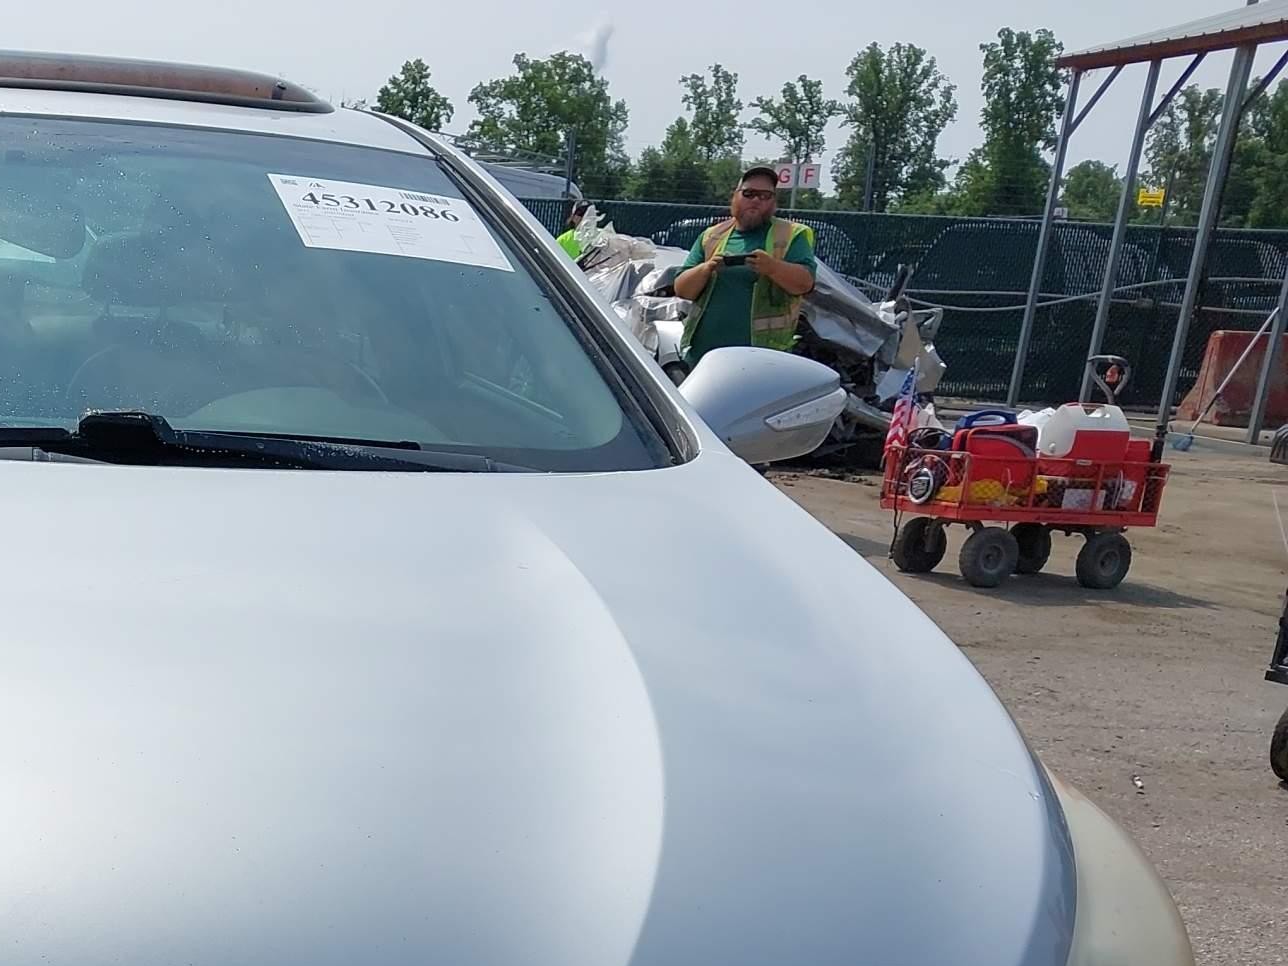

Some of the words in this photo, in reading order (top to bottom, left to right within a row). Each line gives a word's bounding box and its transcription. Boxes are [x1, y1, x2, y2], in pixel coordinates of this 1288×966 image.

[779, 168, 791, 184] G
[804, 168, 815, 184] F
[302, 191, 460, 222] 45312086
